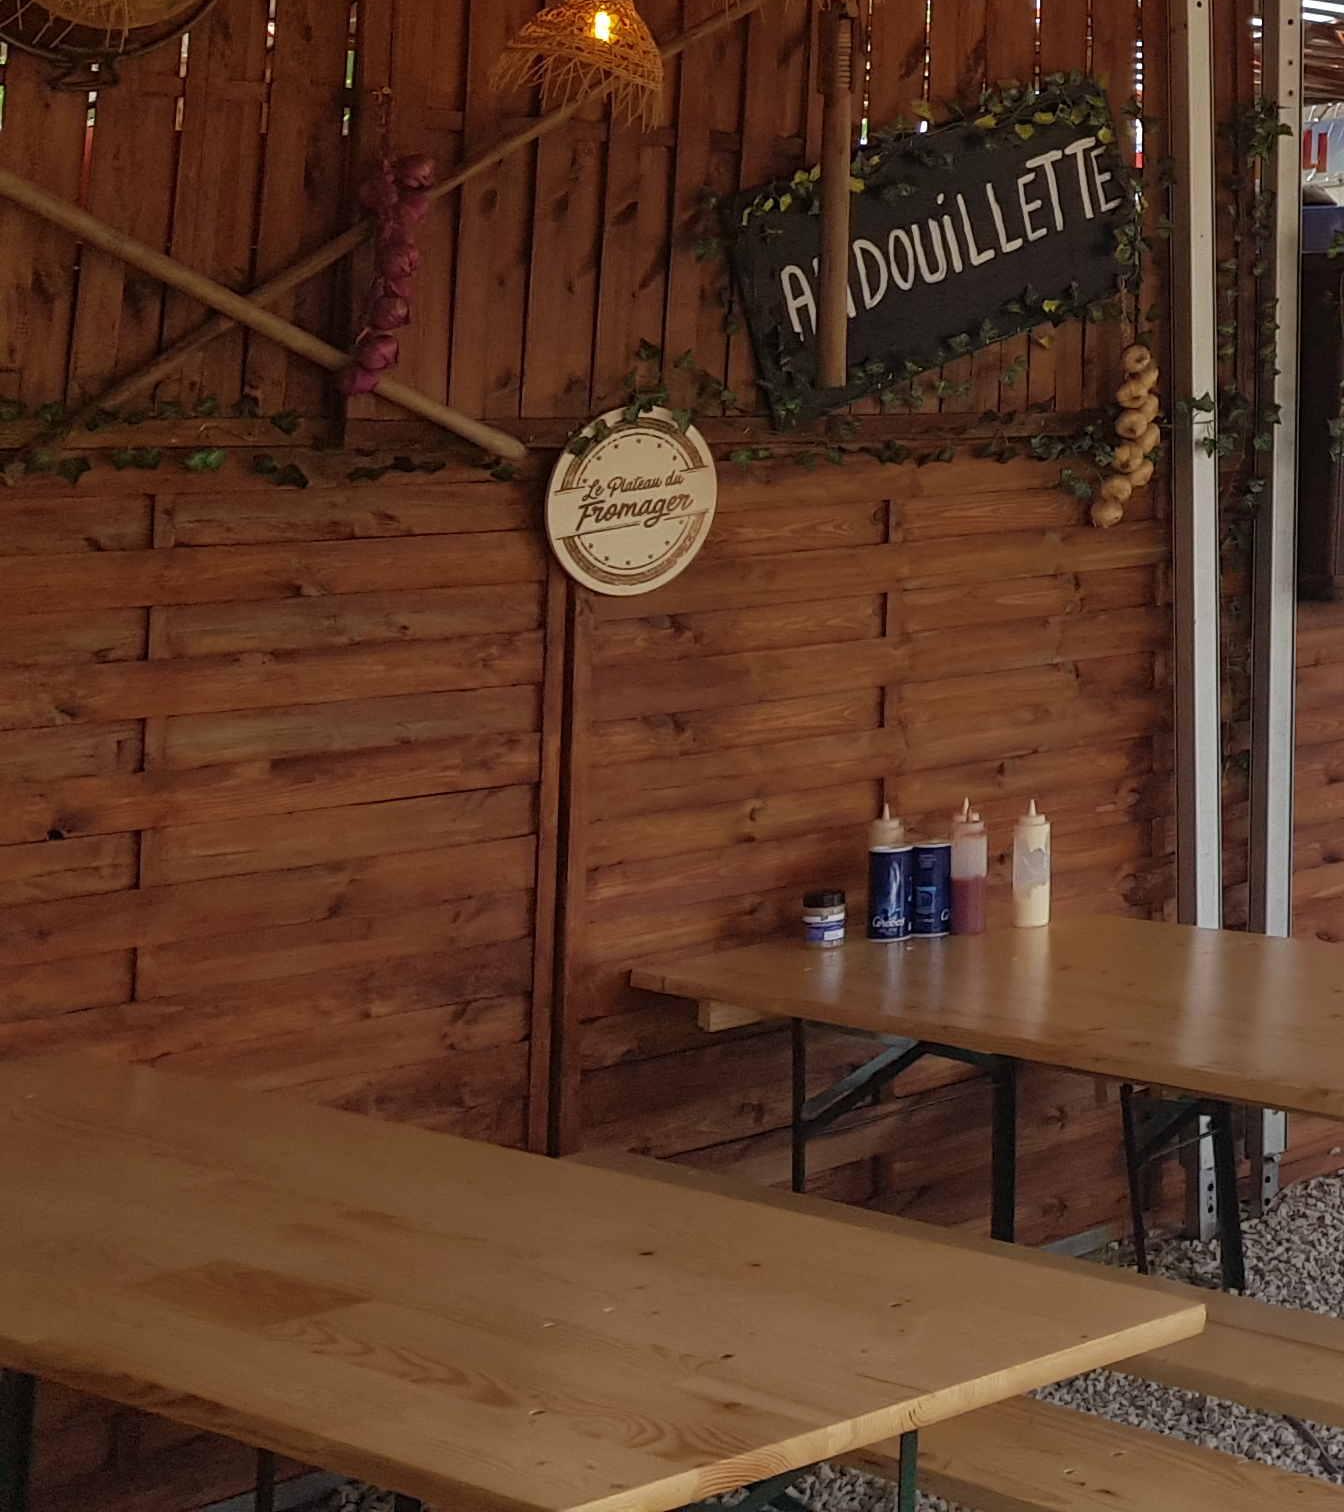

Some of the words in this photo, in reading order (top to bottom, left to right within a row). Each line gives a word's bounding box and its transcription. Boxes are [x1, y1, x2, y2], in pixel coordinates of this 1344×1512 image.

[780, 136, 1123, 336] ADOUiLLETTE
[581, 478, 604, 502] Le
[607, 475, 662, 498] Plateau
[665, 469, 685, 487] du
[575, 493, 694, 532] Fromager
